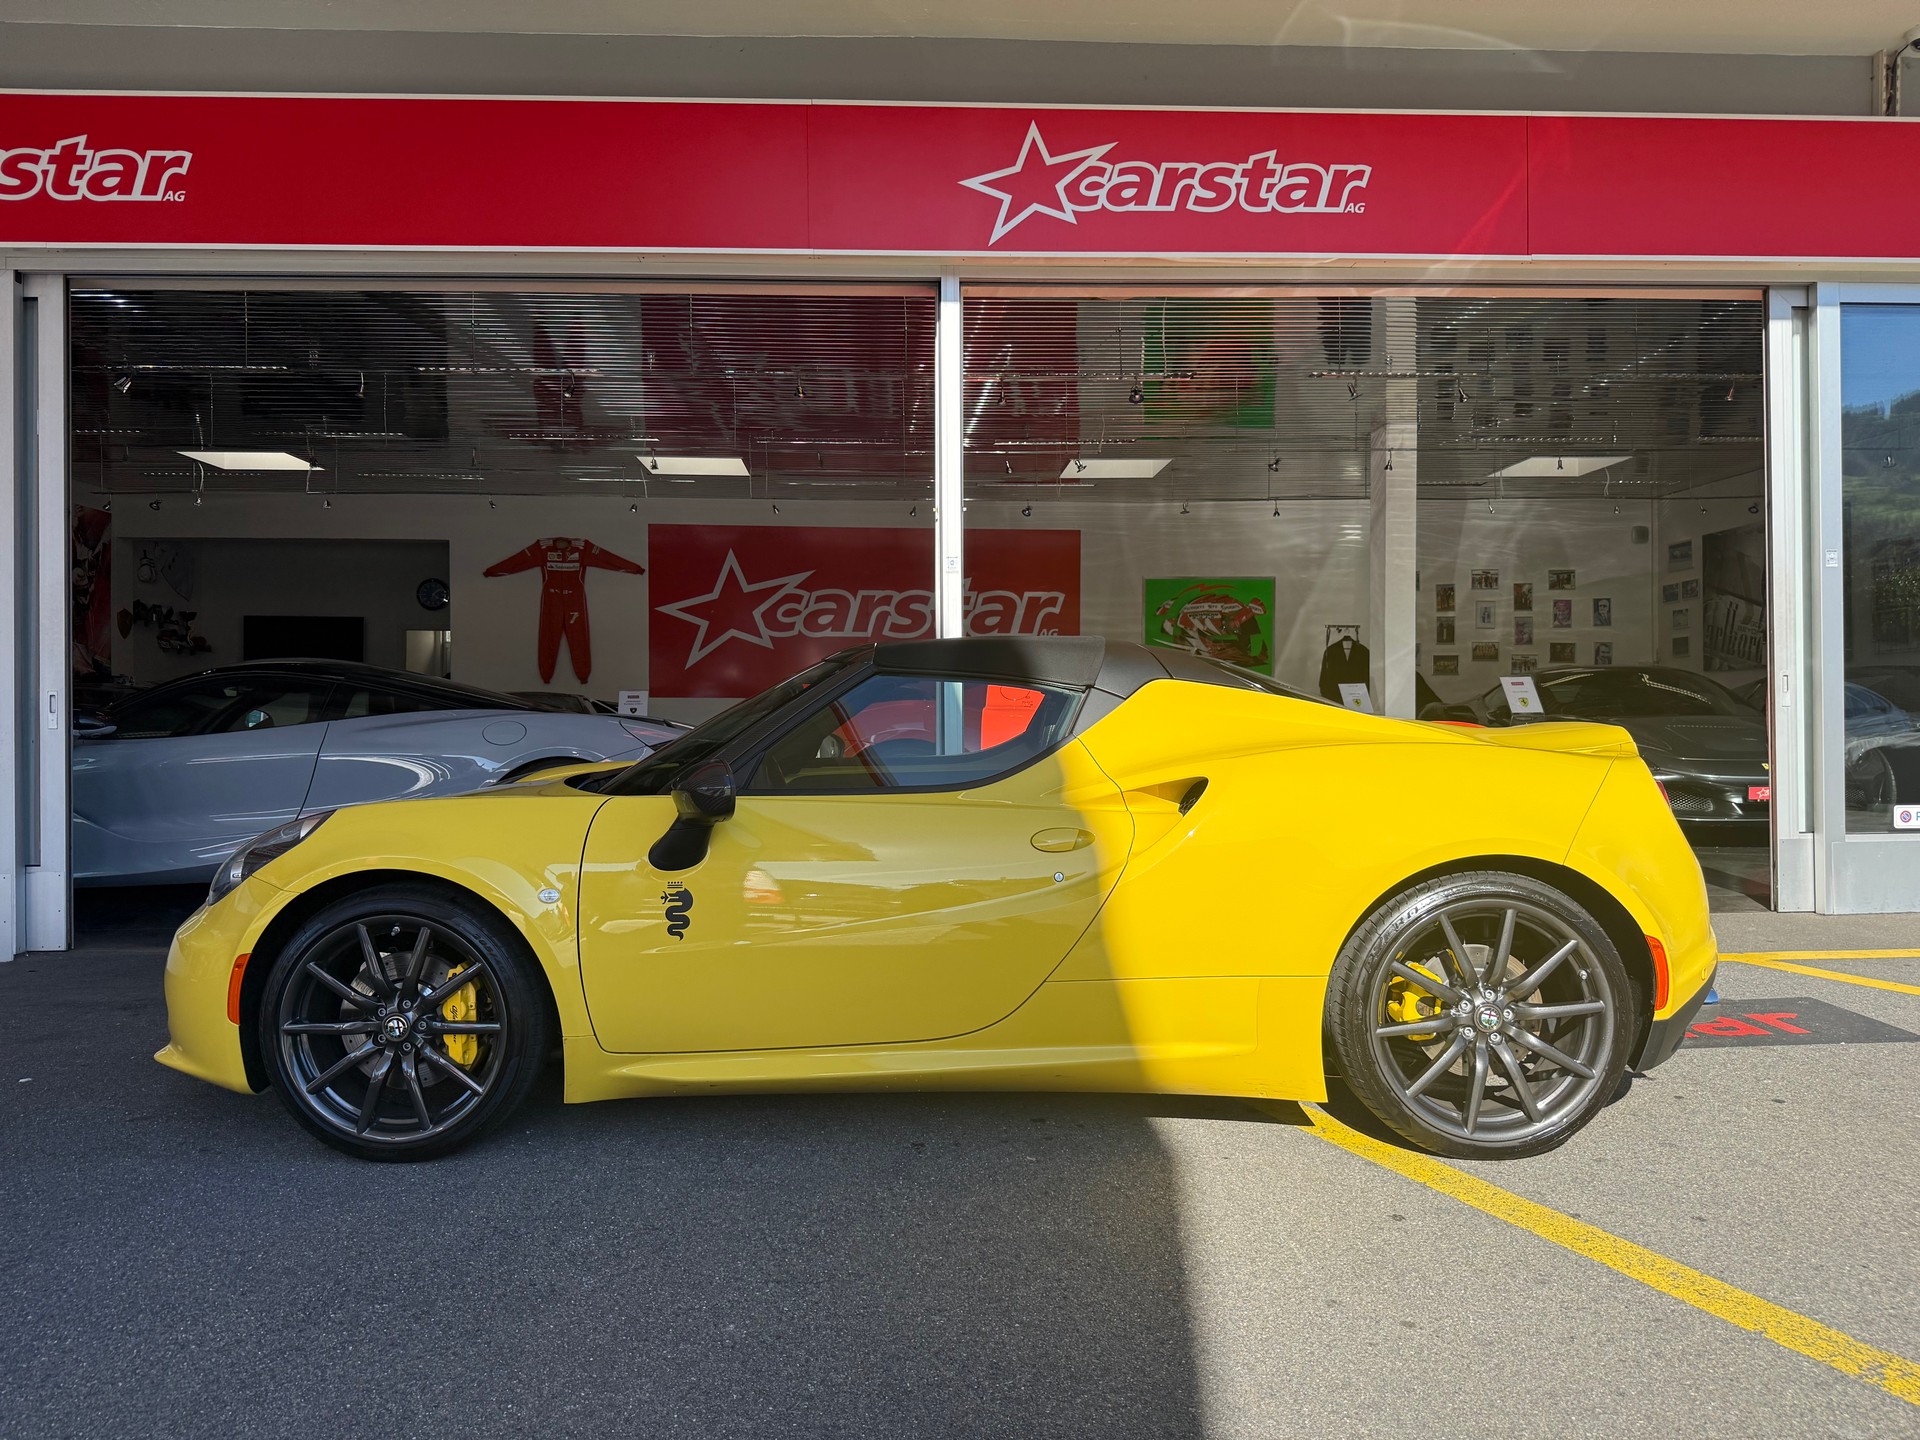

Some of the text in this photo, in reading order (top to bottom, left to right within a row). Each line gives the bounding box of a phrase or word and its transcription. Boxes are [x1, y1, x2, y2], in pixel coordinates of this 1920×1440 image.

[0, 134, 193, 202] star AG
[1065, 149, 1372, 214] carstar AG
[570, 612, 579, 624] 7
[1685, 1012, 1813, 1039] ar
